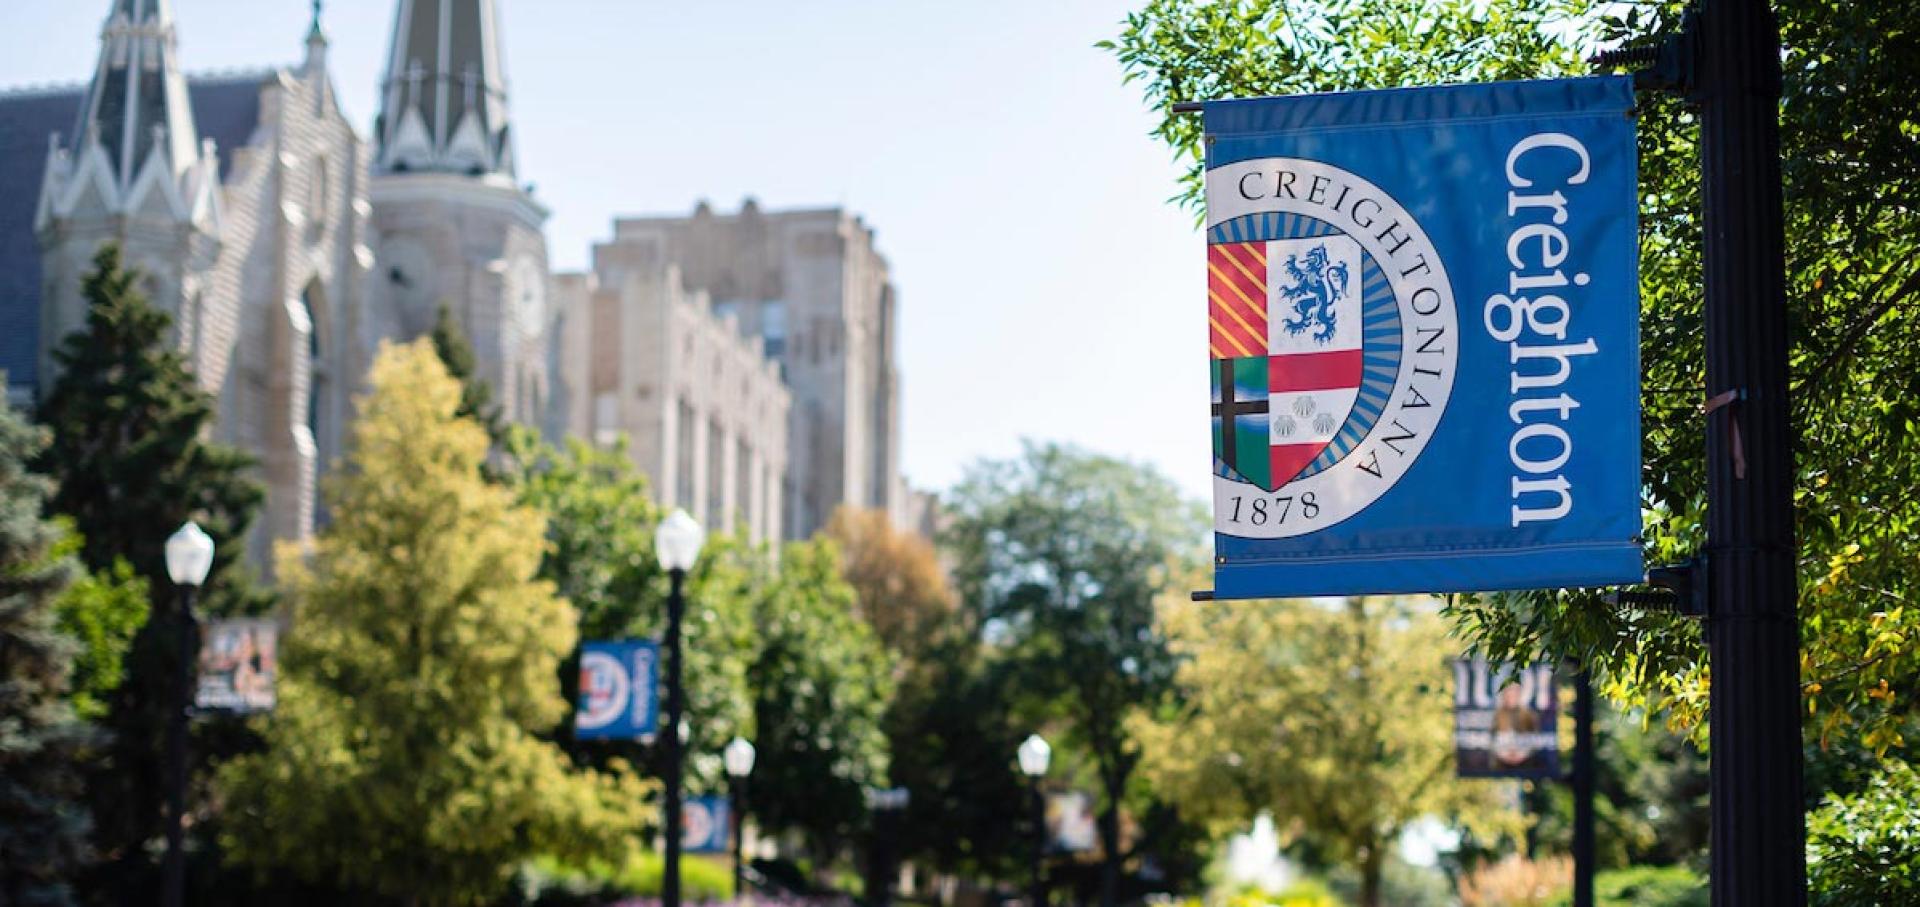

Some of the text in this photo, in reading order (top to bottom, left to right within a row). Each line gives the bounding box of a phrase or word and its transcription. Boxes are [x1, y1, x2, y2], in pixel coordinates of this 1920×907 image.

[1238, 170, 1445, 480] CREIGHTONIANA
[1485, 132, 1599, 527] Creighton
[1228, 491, 1321, 526] 1878
